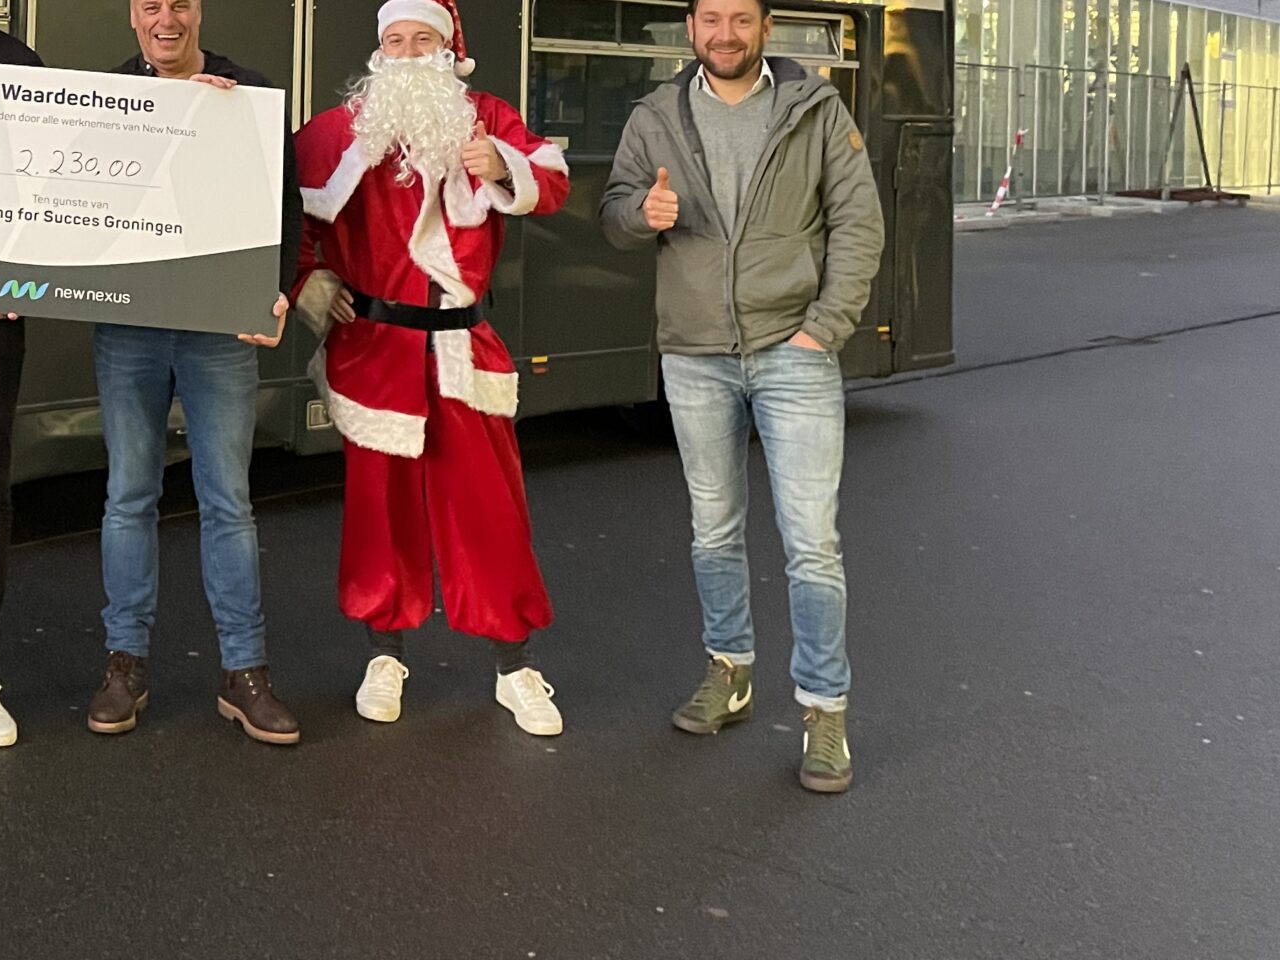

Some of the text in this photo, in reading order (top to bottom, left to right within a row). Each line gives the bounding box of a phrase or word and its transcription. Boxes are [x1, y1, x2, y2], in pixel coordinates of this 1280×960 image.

[1, 83, 155, 115] Waardecheque
[18, 113, 40, 123] door
[42, 115, 59, 125] alle
[61, 118, 121, 130] werknemers
[123, 123, 140, 132] van
[143, 124, 164, 134] New
[166, 126, 197, 137] Nexus
[32, 194, 109, 209] Ten gunste van
[18, 207, 39, 221] for
[43, 210, 100, 227] Succes
[104, 215, 183, 236] Groningen
